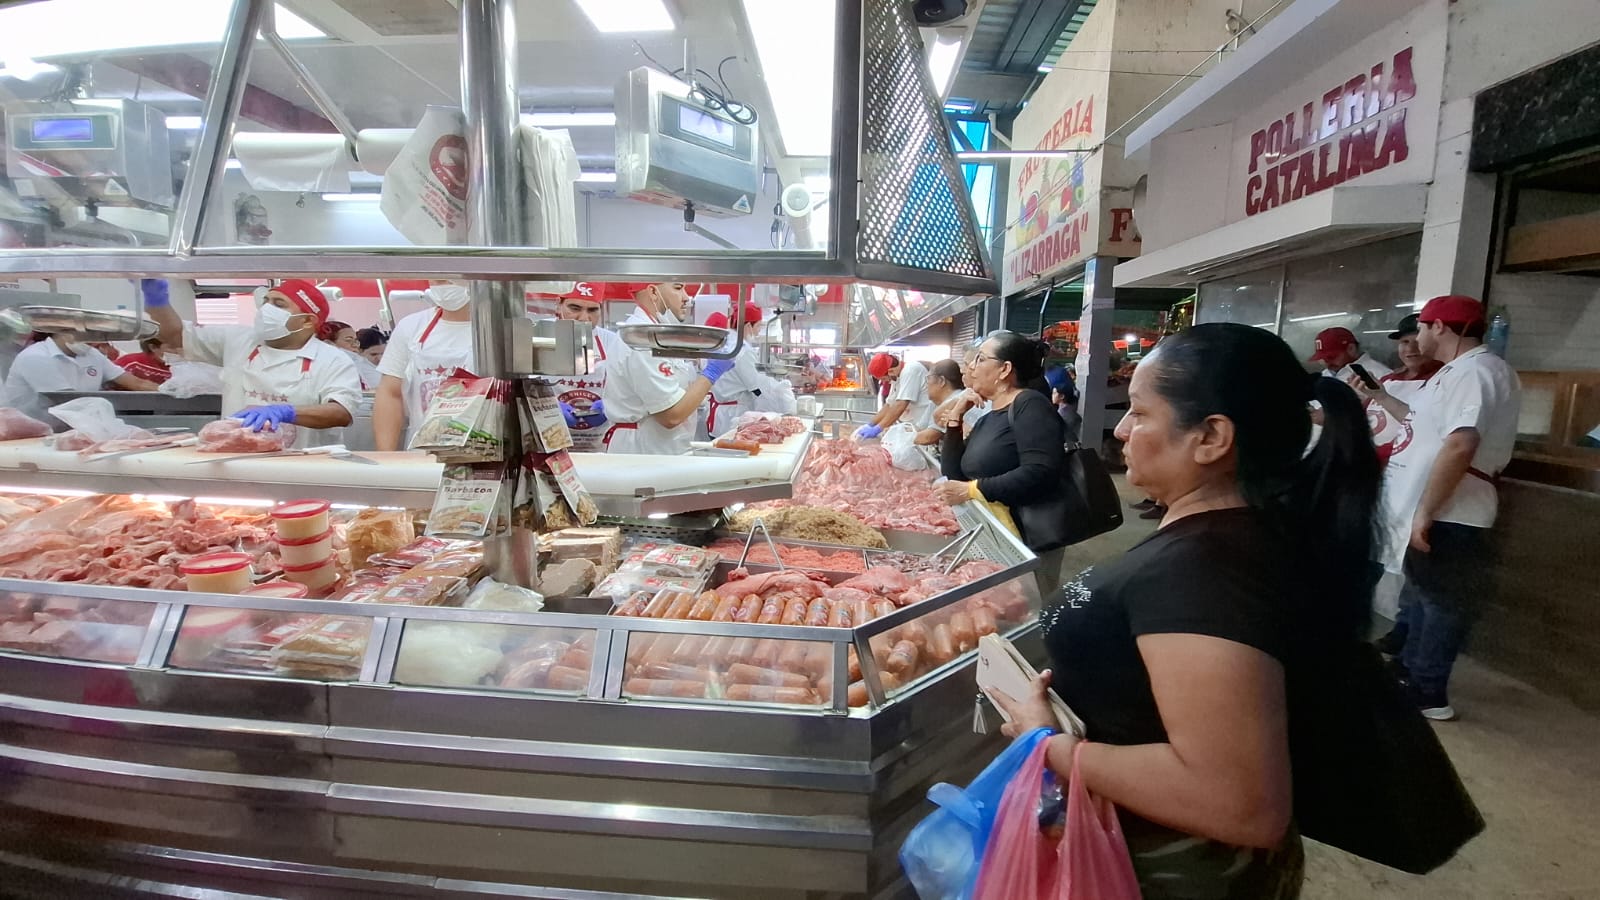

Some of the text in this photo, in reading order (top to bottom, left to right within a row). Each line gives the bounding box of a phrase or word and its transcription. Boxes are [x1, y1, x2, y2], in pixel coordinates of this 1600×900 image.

[1018, 94, 1095, 194] FRUTERIA
[1248, 46, 1417, 174] POLLERIA
[1245, 108, 1409, 217] CATALINA
[575, 281, 594, 297] CK
[658, 361, 675, 377] CK
